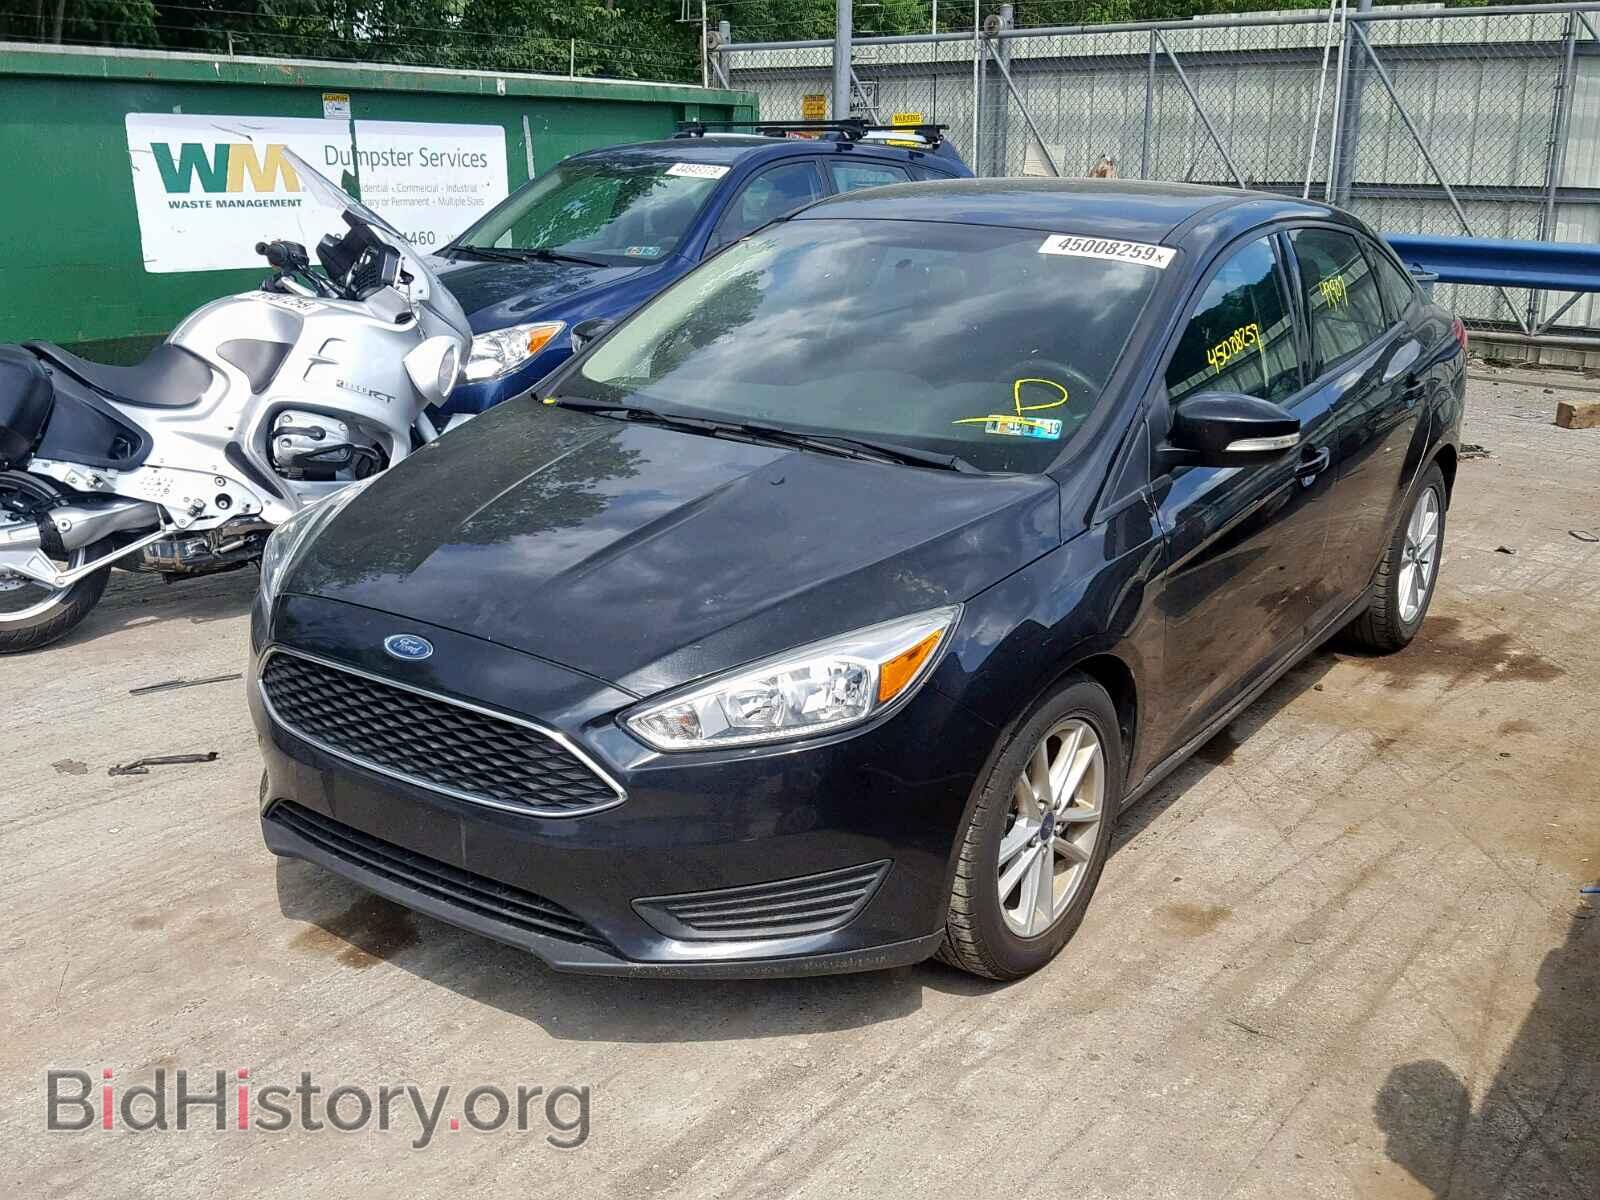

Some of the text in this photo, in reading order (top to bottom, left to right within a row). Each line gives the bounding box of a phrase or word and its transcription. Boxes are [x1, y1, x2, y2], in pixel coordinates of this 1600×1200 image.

[325, 145, 488, 172] Dumpster Services
[168, 198, 303, 209] WASTE MANAGEMENT
